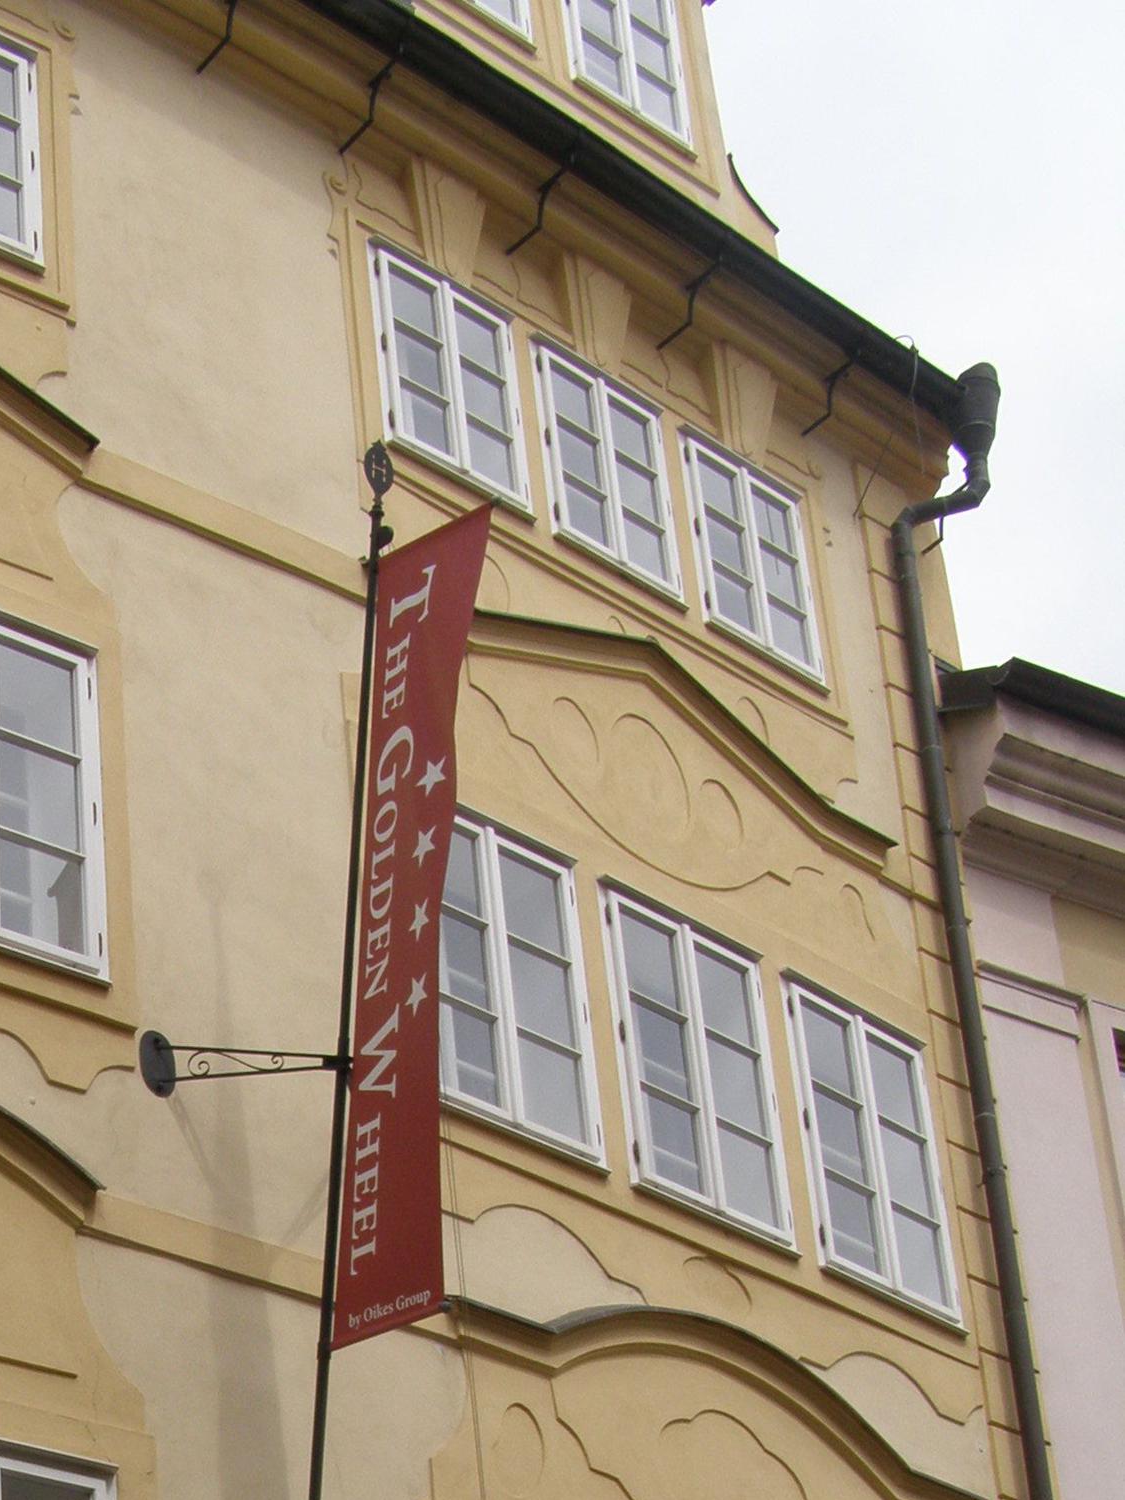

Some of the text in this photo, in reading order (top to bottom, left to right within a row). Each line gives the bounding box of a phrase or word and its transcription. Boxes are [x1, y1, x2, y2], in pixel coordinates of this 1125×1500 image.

[350, 564, 437, 1276] THE GOLDEN WHEEL
[348, 1289, 431, 1331] by Oikes Group
